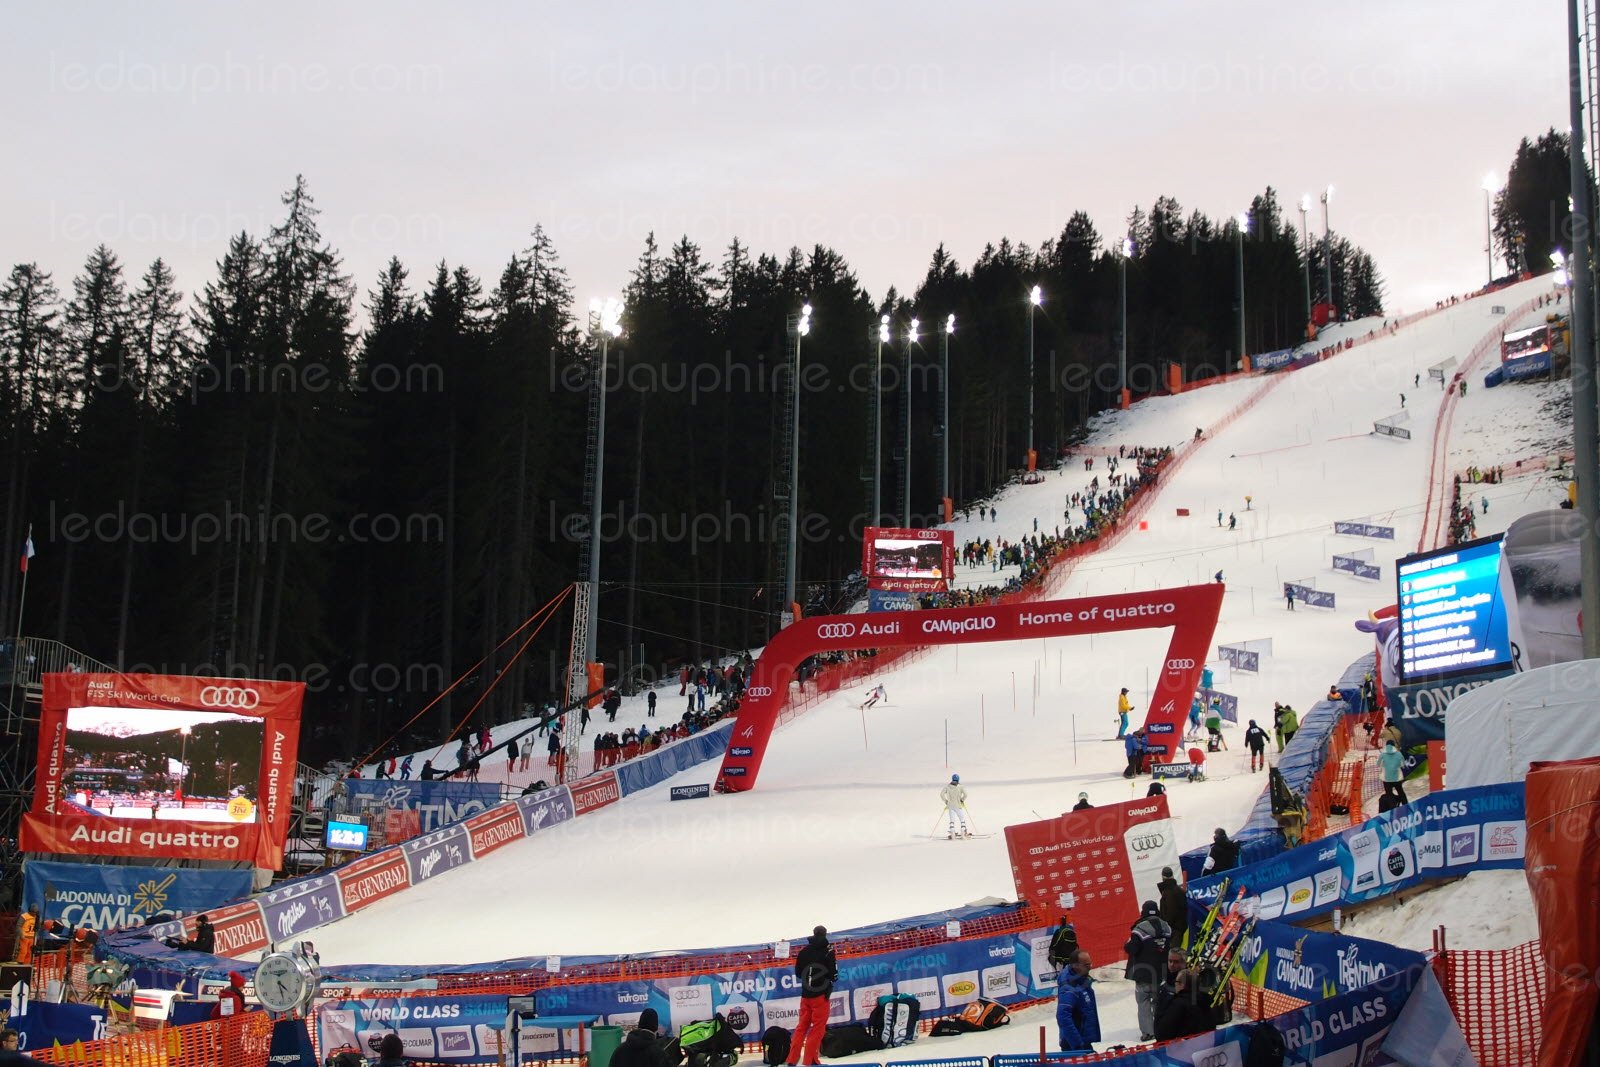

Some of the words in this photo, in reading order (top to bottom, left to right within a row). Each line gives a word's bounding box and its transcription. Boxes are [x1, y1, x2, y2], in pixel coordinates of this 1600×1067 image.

[881, 580, 901, 588] Audi
[903, 581, 936, 589] quattro
[1019, 611, 1073, 626] Home
[1078, 606, 1099, 620] of
[1103, 602, 1176, 620] quattro
[860, 621, 900, 635] Audi
[88, 680, 114, 689] Audi
[87, 690, 105, 698] FIS
[107, 690, 123, 699] Ski
[125, 691, 157, 701] World
[159, 694, 181, 704] Cup
[49, 722, 63, 779] quattro
[271, 730, 285, 765] Audi
[45, 782, 57, 815] Audi
[267, 768, 279, 824] quattro
[584, 783, 618, 808] GENERALI
[672, 785, 708, 796] LONGINES
[335, 813, 361, 824] LONGINES
[530, 803, 549, 831] Milka
[1380, 810, 1423, 838] WORLD
[1426, 800, 1467, 820] CLASS
[1471, 793, 1519, 814] SKIING
[70, 824, 132, 844] Audi
[140, 827, 239, 849] quattro
[484, 816, 523, 848] GENERALI
[1045, 844, 1060, 852] Audi
[1082, 837, 1101, 845] World
[1452, 836, 1473, 854] Milka
[420, 848, 442, 880] Milka
[357, 863, 407, 900] GENERALI
[117, 894, 131, 907] DI
[278, 901, 307, 937] Milka
[213, 918, 265, 954] ENERALI
[988, 945, 1015, 957] infront
[838, 962, 889, 981] SKIING
[892, 952, 948, 974] ACTION
[323, 989, 344, 998] SPOR
[718, 977, 777, 995] WORLD
[617, 992, 649, 1003] infront
[360, 1005, 410, 1022] WORLD
[413, 1003, 460, 1019] CLASS
[775, 1010, 799, 1019] COLMA
[1329, 996, 1387, 1034] CLASS
[408, 1038, 432, 1047] COLMAR
[445, 1033, 467, 1048] Milka
[269, 1054, 301, 1062] LONGINES
